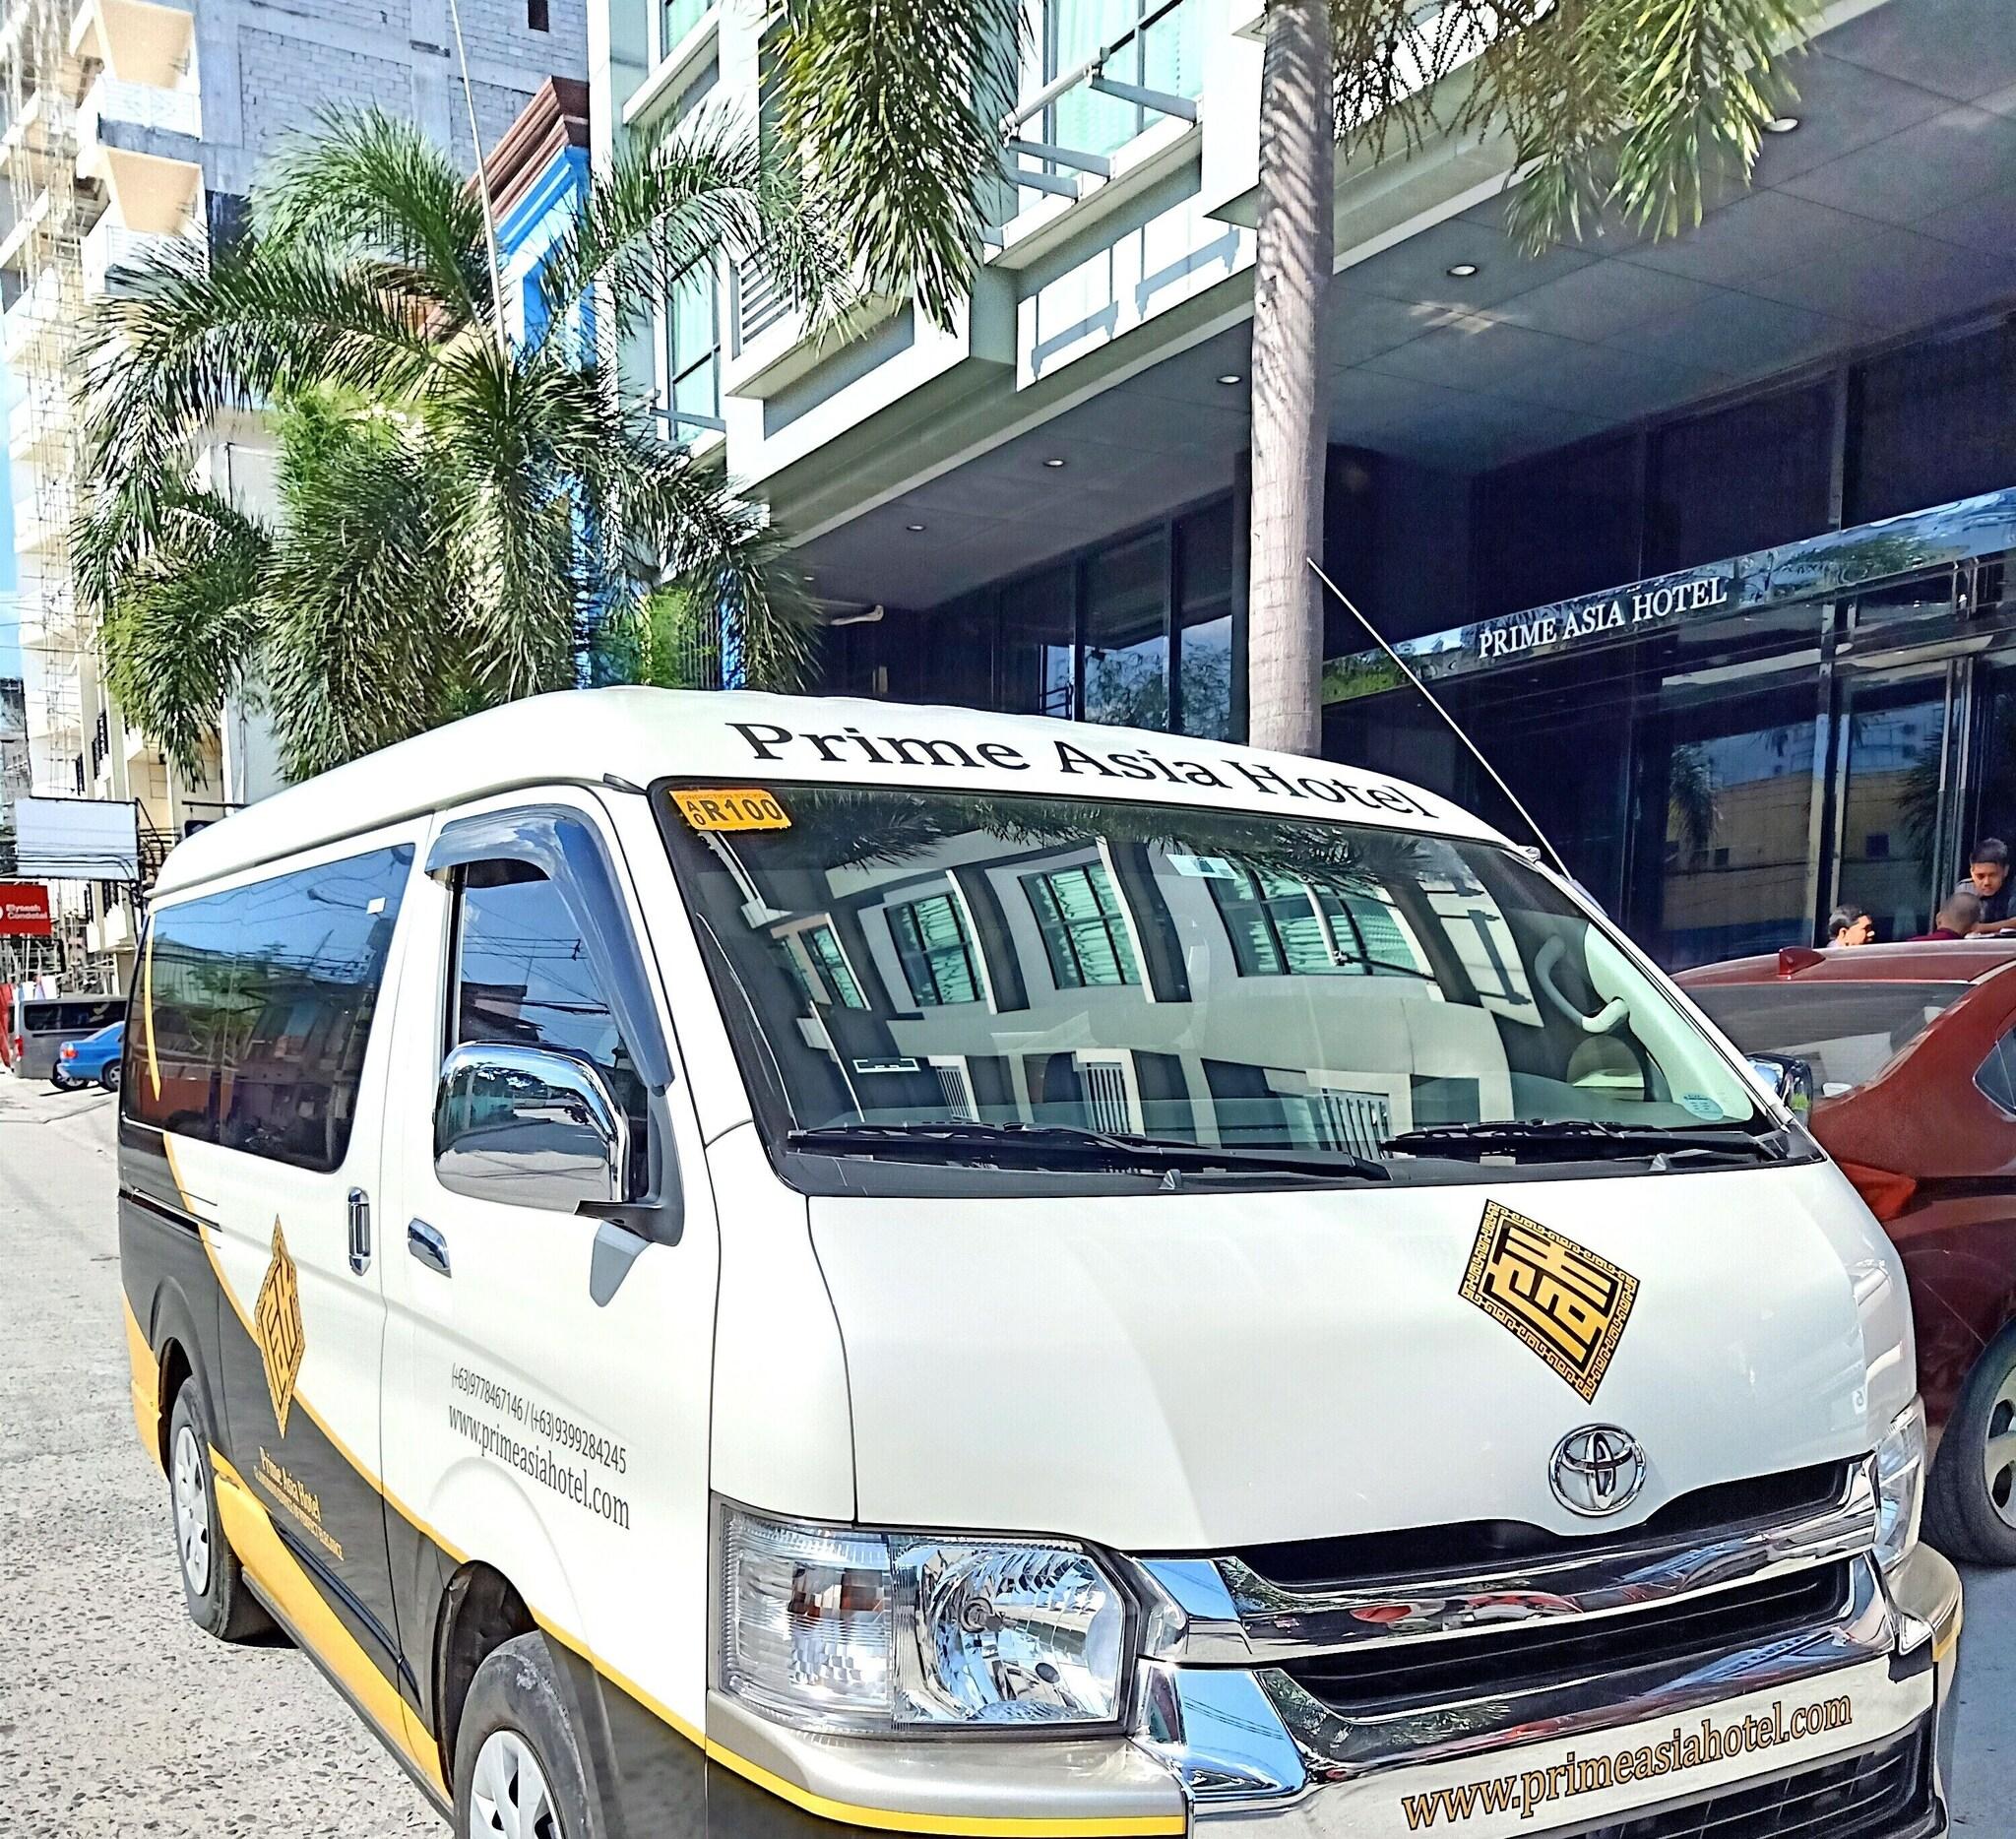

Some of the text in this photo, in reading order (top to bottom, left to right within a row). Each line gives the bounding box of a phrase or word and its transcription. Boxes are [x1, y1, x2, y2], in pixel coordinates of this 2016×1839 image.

[1479, 576, 1728, 659] PRIME ASIA HOTEL
[724, 723, 1439, 819] Prime Asia Hotel
[449, 1405, 630, 1530] www.primeasiahotel.com
[532, 1403, 626, 1474] (+63)9399284245
[1402, 1694, 1853, 1831] www.primeasiahotel.com
